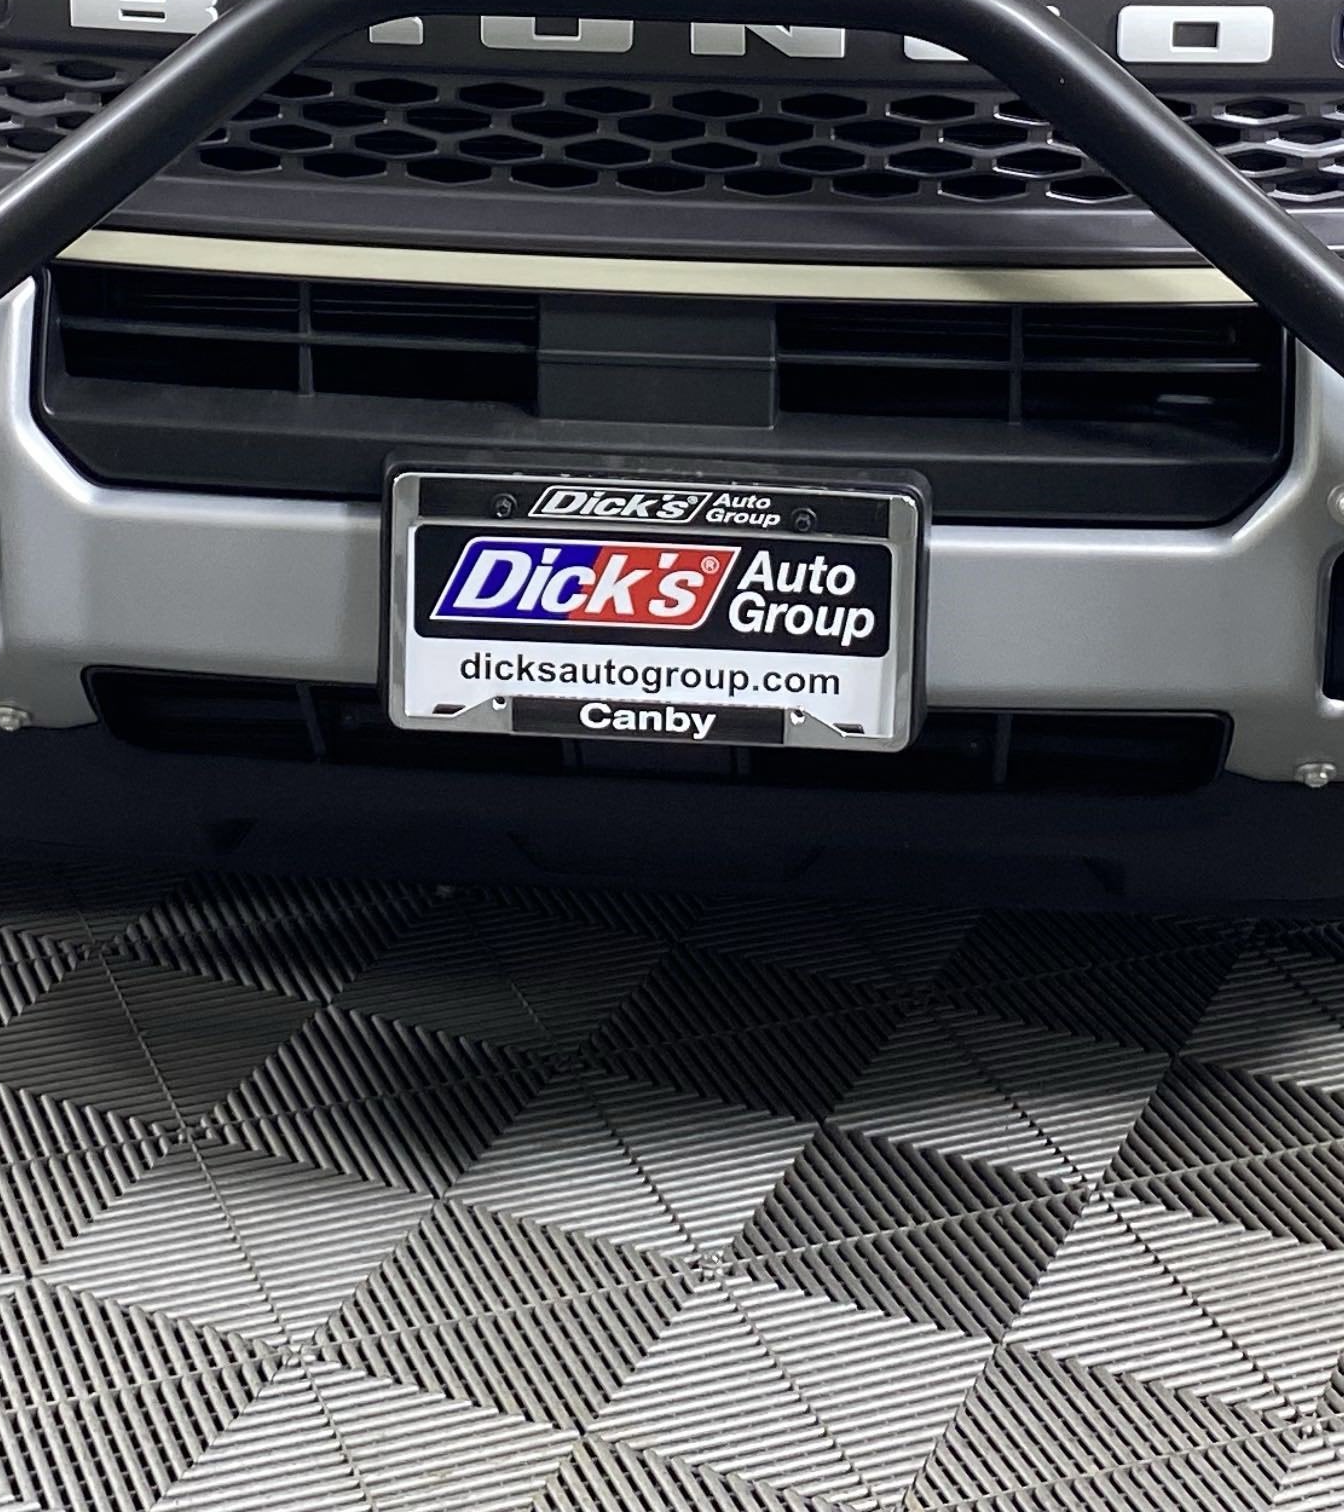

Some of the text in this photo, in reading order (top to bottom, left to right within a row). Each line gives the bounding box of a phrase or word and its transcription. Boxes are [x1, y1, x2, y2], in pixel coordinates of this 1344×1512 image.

[540, 490, 772, 519] Dick's Auto
[706, 508, 781, 529] Group
[453, 548, 856, 617] Dick's Auto
[728, 592, 875, 646] Group
[460, 652, 840, 695] dicksautogroup.com
[579, 701, 716, 740] Canby
